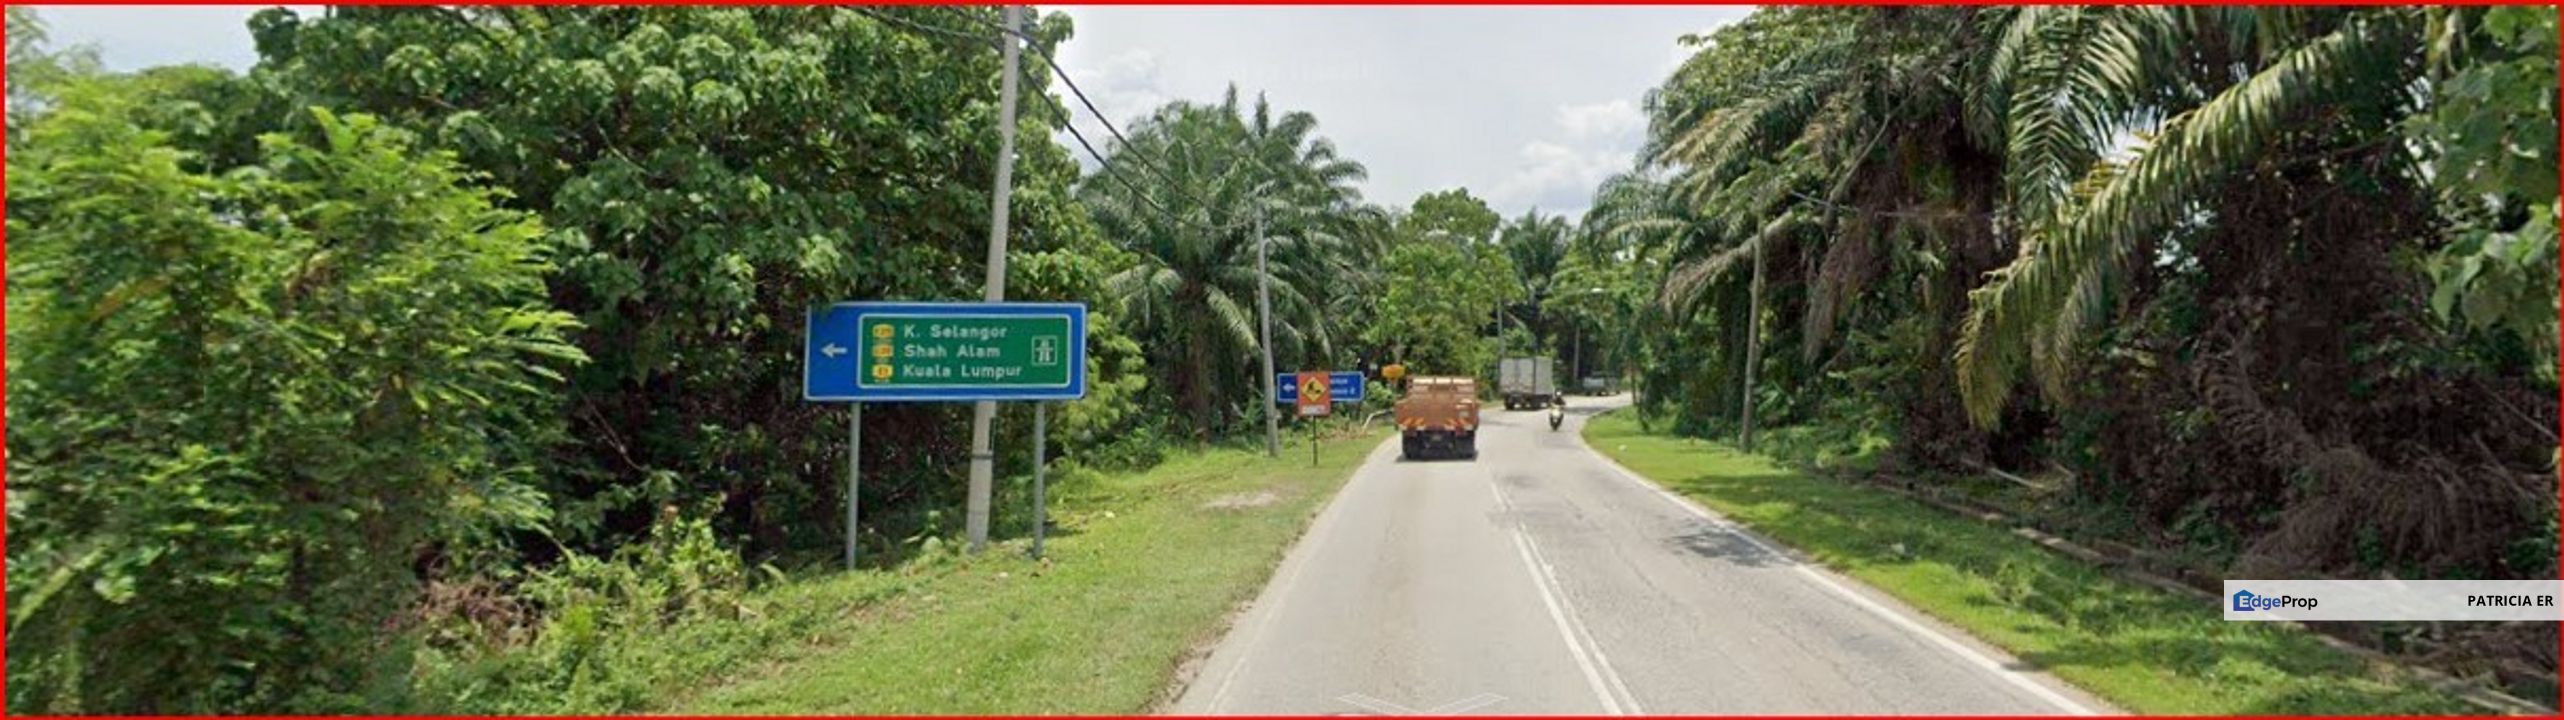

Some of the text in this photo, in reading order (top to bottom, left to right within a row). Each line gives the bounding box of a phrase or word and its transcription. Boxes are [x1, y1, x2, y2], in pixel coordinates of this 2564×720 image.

[903, 324, 920, 338] K.
[930, 324, 1008, 341] Selangor
[903, 345, 947, 358] Shah
[956, 344, 1000, 358] Alam
[903, 364, 951, 378] Kuala
[961, 364, 1023, 380] Lumpur
